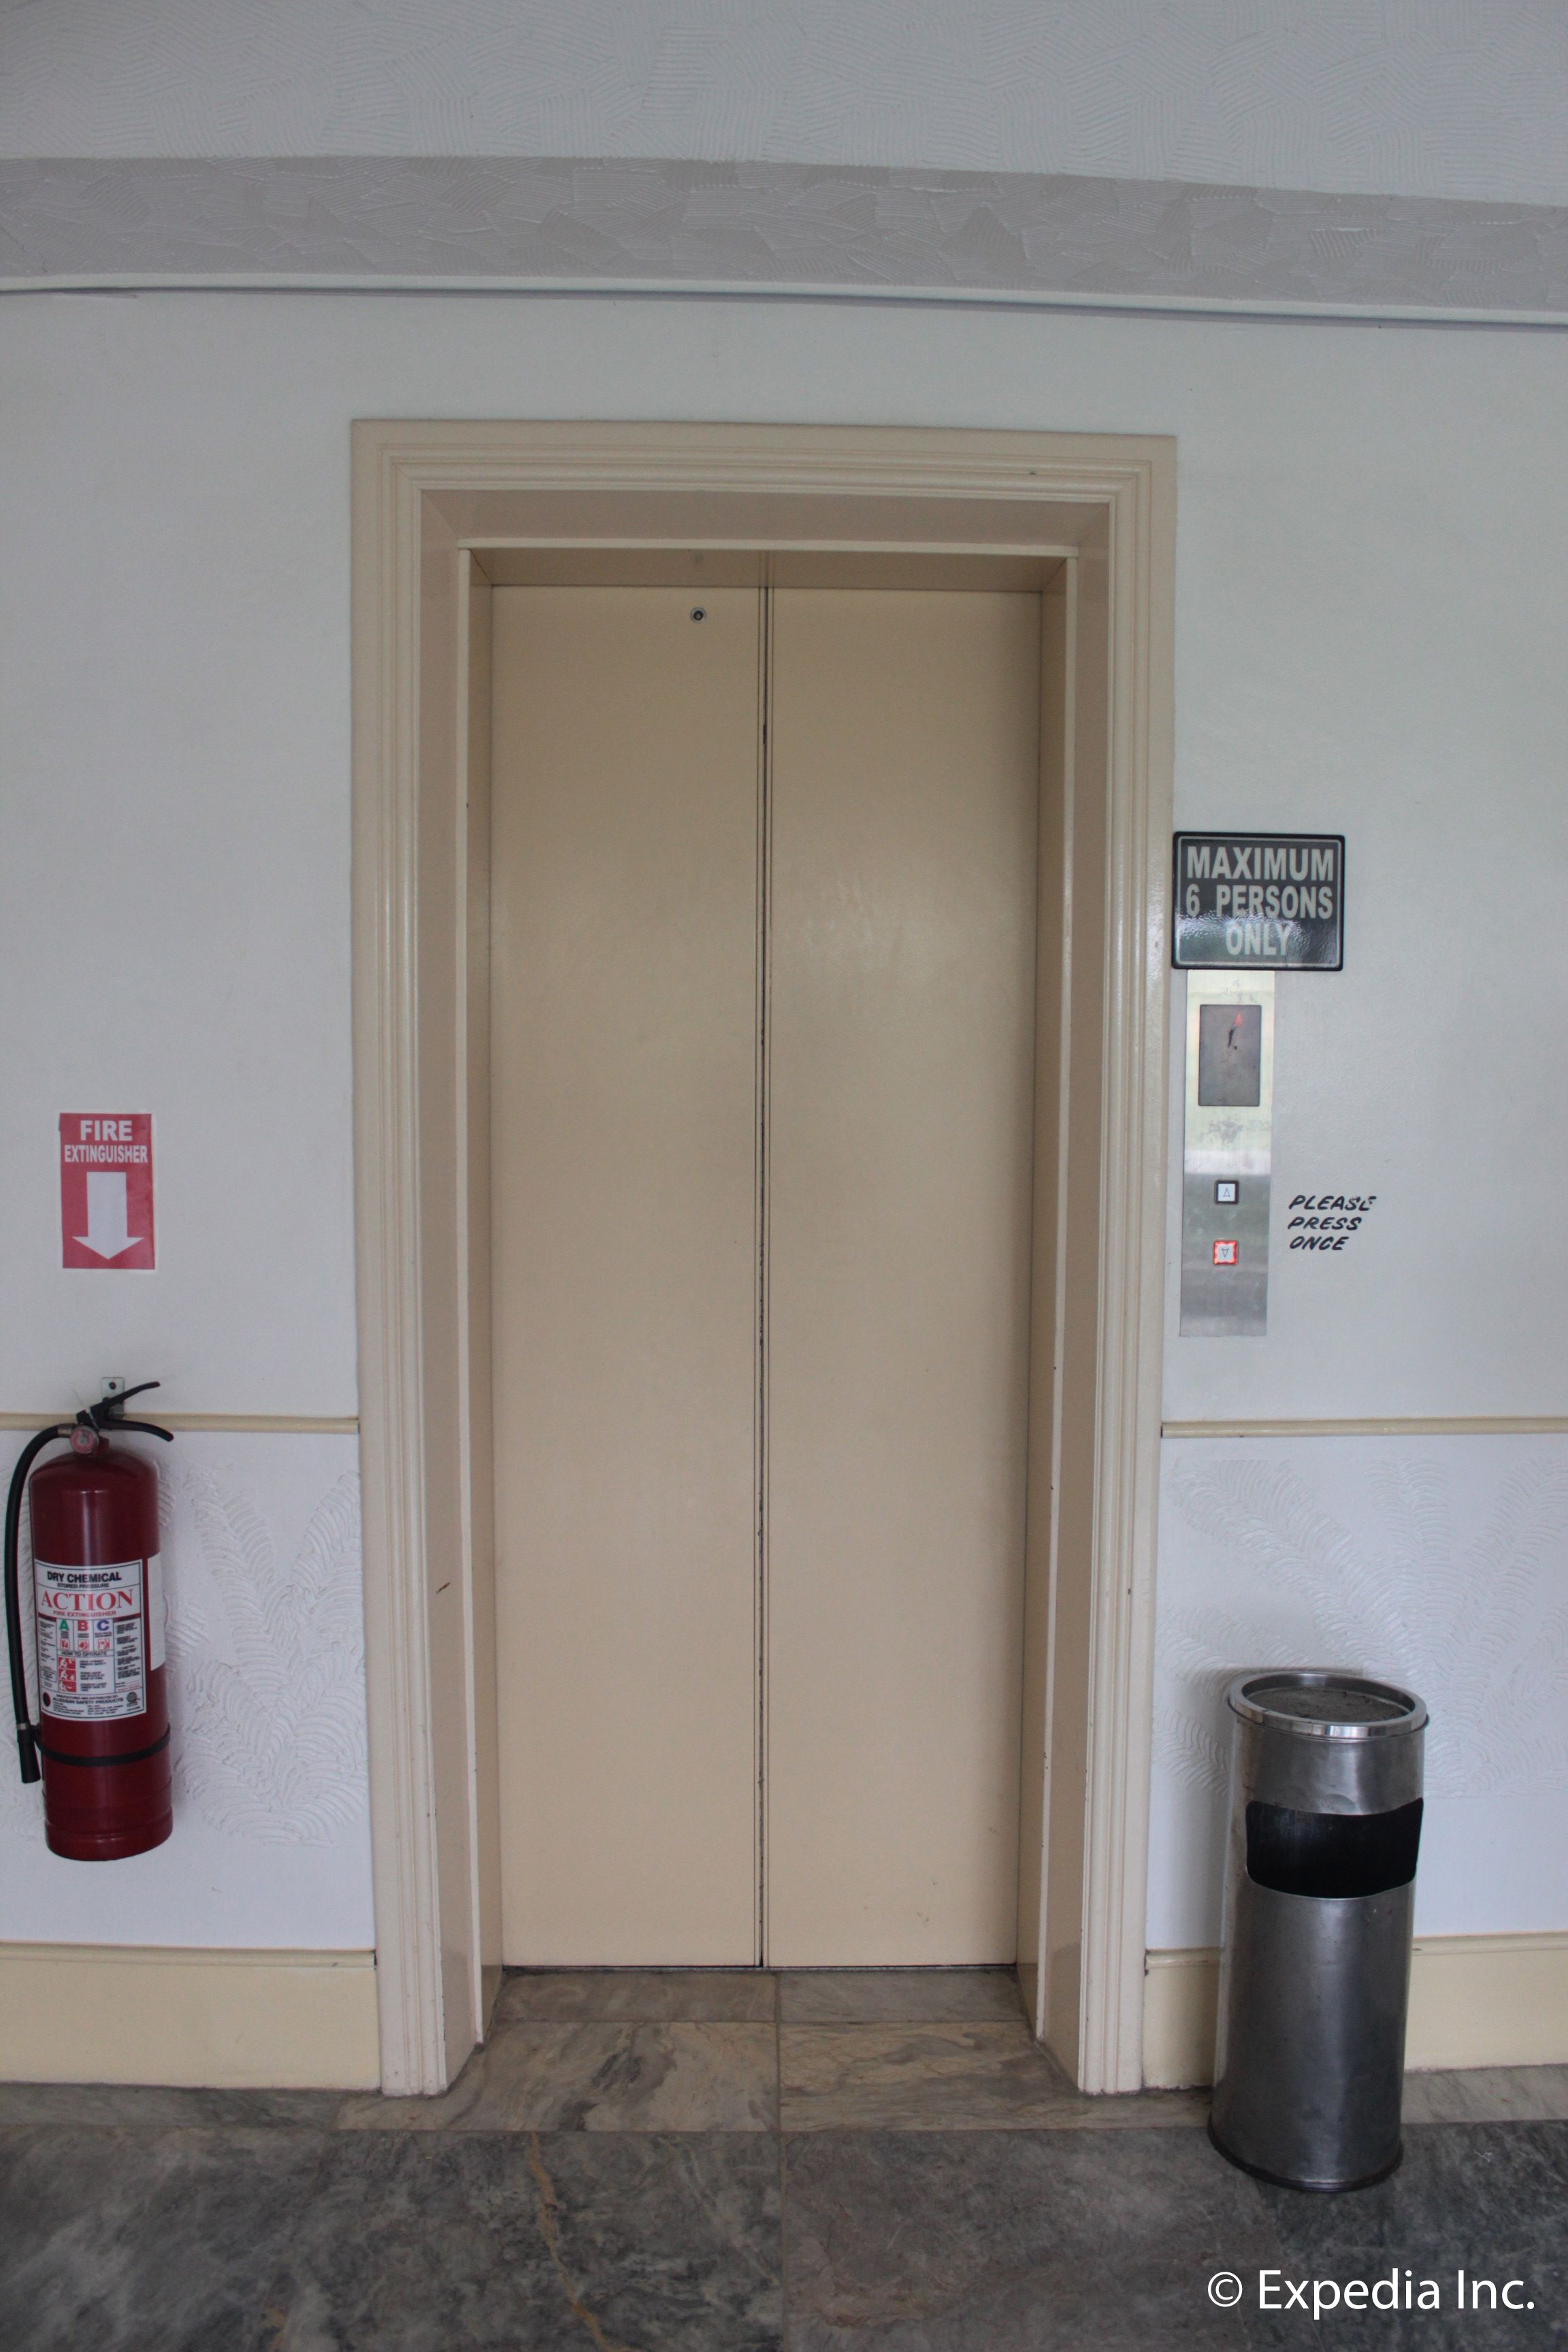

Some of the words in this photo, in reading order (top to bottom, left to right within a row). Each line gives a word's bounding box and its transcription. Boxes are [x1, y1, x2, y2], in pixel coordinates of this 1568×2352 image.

[1187, 846, 1334, 881] MAXIMUM
[1186, 883, 1200, 917] 6
[1215, 884, 1334, 919] PERSONS
[1226, 922, 1292, 956] ONLY
[80, 1120, 133, 1141] FIRE
[64, 1144, 148, 1164] EXTINGUISHER
[1288, 1194, 1377, 1211] PLEASE
[1287, 1216, 1362, 1230] PRESS
[1289, 1235, 1350, 1251] ONCE
[47, 1571, 65, 1582] DRY
[67, 1571, 122, 1584] CHEMICAL
[42, 1588, 134, 1611] ACTION
[67, 1610, 116, 1618] EXTINGUISHER
[59, 1619, 69, 1631] A
[78, 1620, 89, 1632] B
[97, 1619, 110, 1632] C
